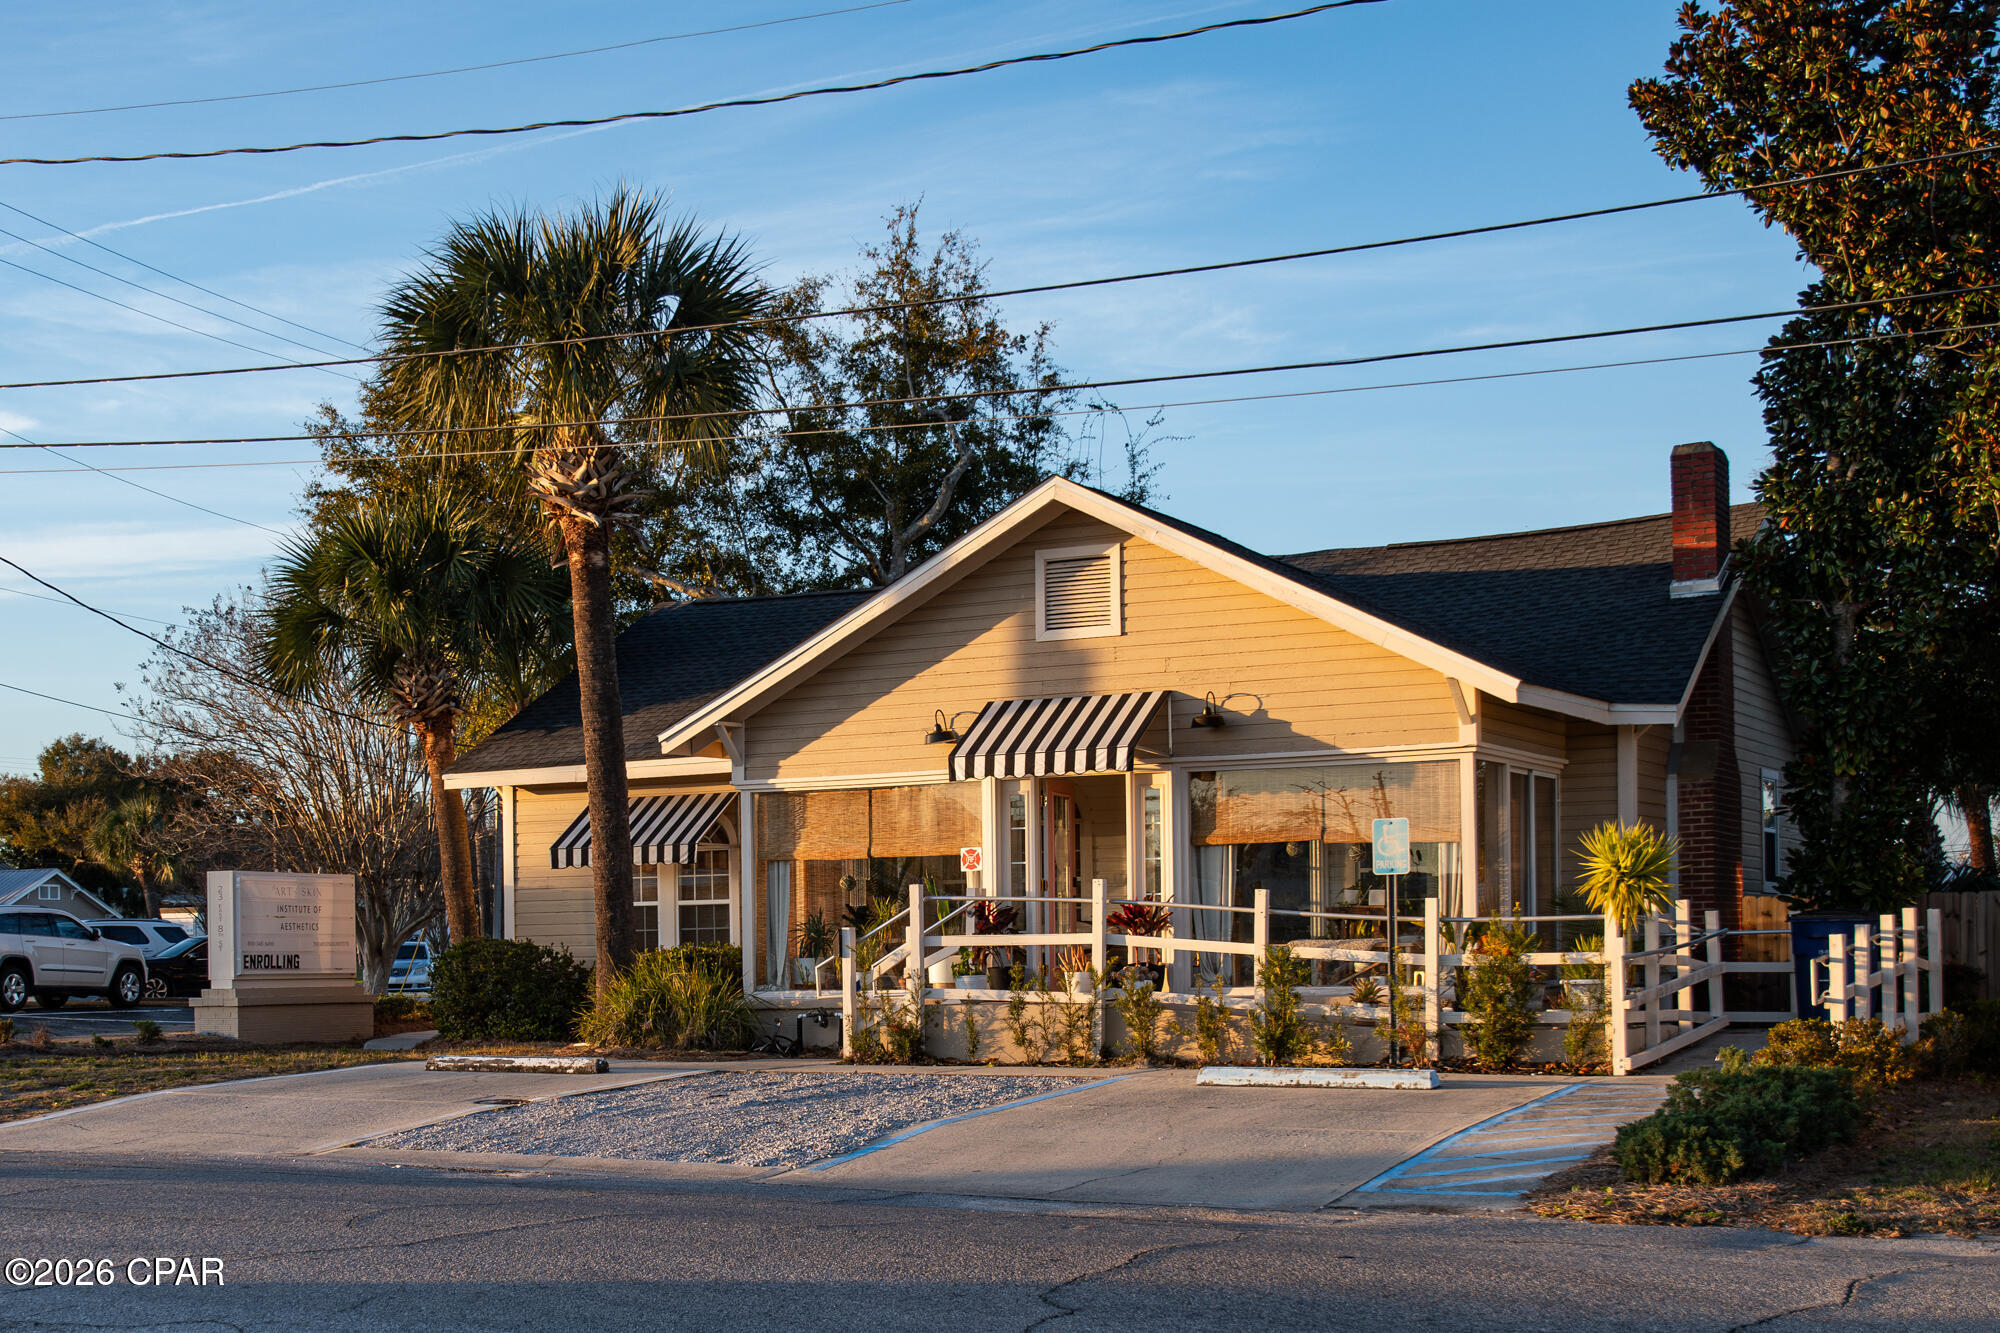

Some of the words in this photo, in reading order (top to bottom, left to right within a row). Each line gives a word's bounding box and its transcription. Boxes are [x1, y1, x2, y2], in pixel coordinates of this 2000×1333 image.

[1376, 859, 1407, 869] PARKING
[277, 904, 311, 913] INSTITUTE
[313, 905, 323, 913] OF
[280, 922, 319, 931] AESTHETICS
[243, 954, 300, 970] ENROLLING
